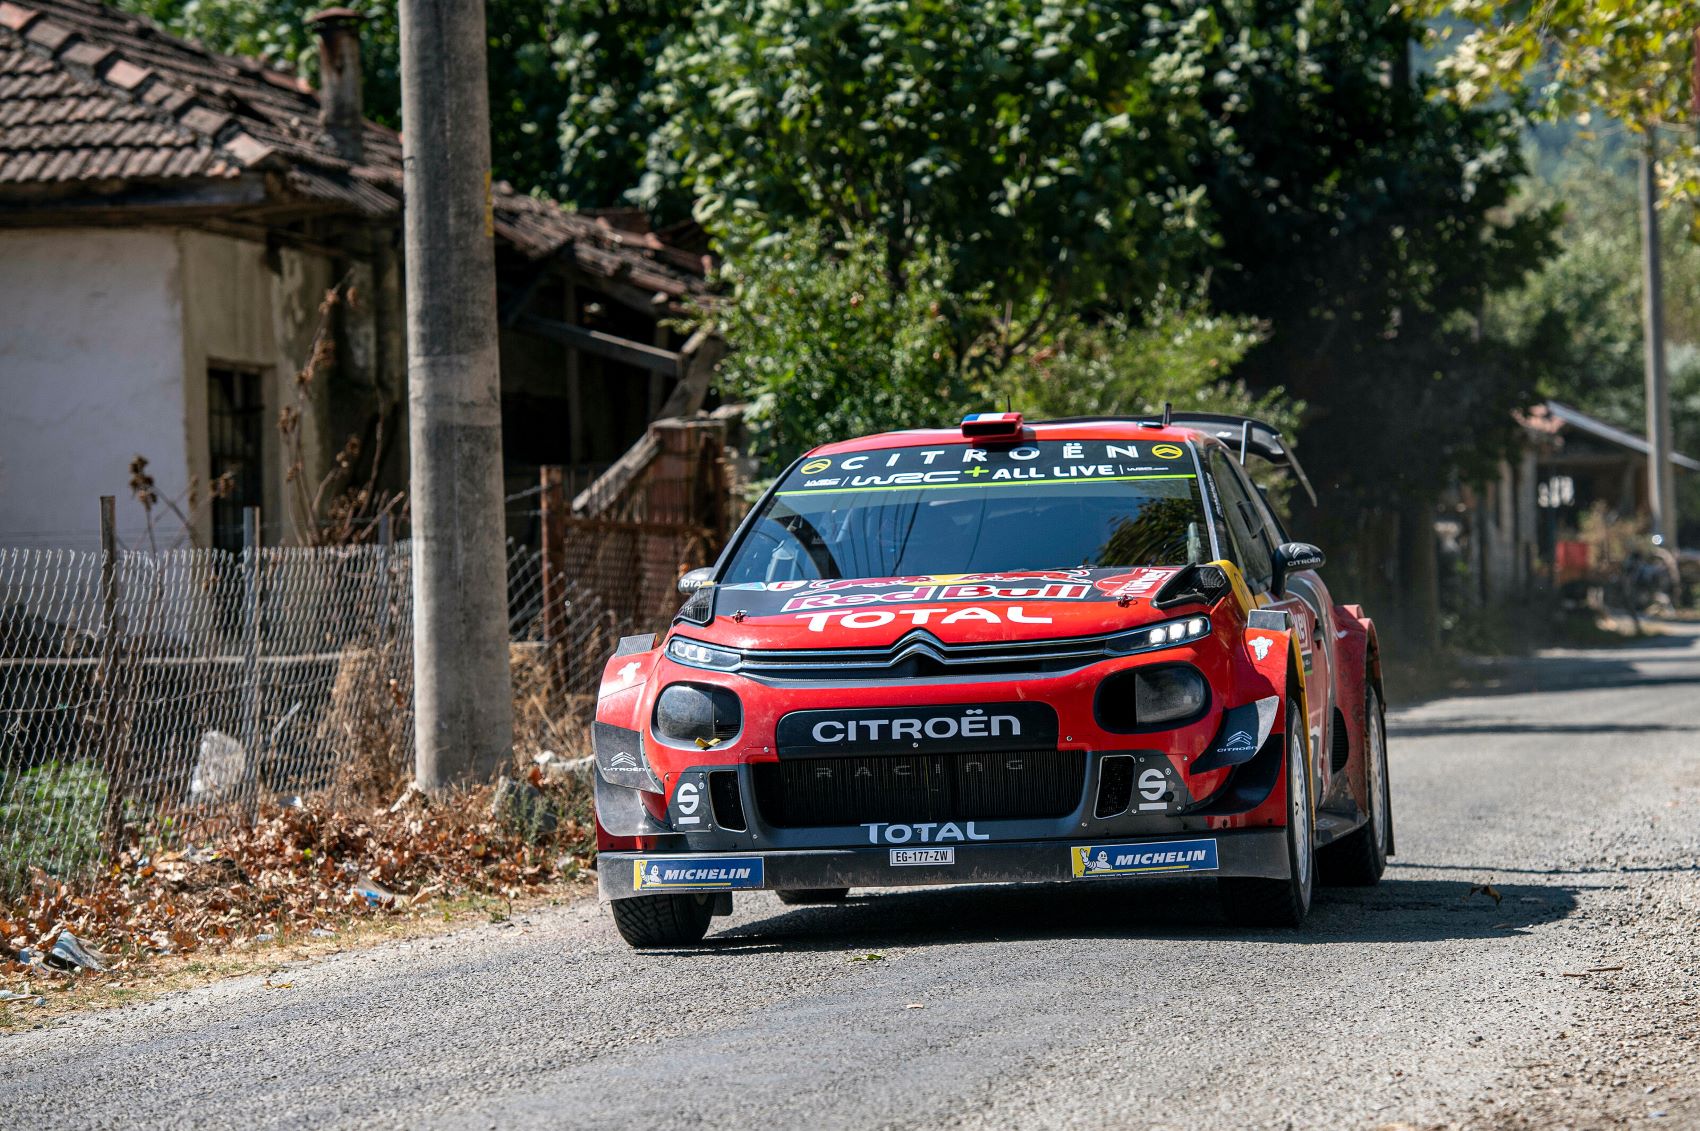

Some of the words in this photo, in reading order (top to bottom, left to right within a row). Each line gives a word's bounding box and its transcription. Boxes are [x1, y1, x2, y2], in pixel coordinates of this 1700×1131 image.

[841, 443, 1139, 470] CITROËN
[992, 467, 1045, 479] ALL
[1053, 465, 1115, 477] LIVE
[781, 586, 936, 612] Red
[937, 583, 1093, 600] Bull
[795, 606, 1053, 632] TOTAL
[812, 709, 1021, 743] CITROËN
[816, 760, 1023, 778] RACING
[860, 821, 990, 845] TOTAL
[896, 850, 948, 863] EG-177-ZW
[1115, 850, 1207, 866] MICHELIN
[663, 868, 751, 881] MICHELIN
